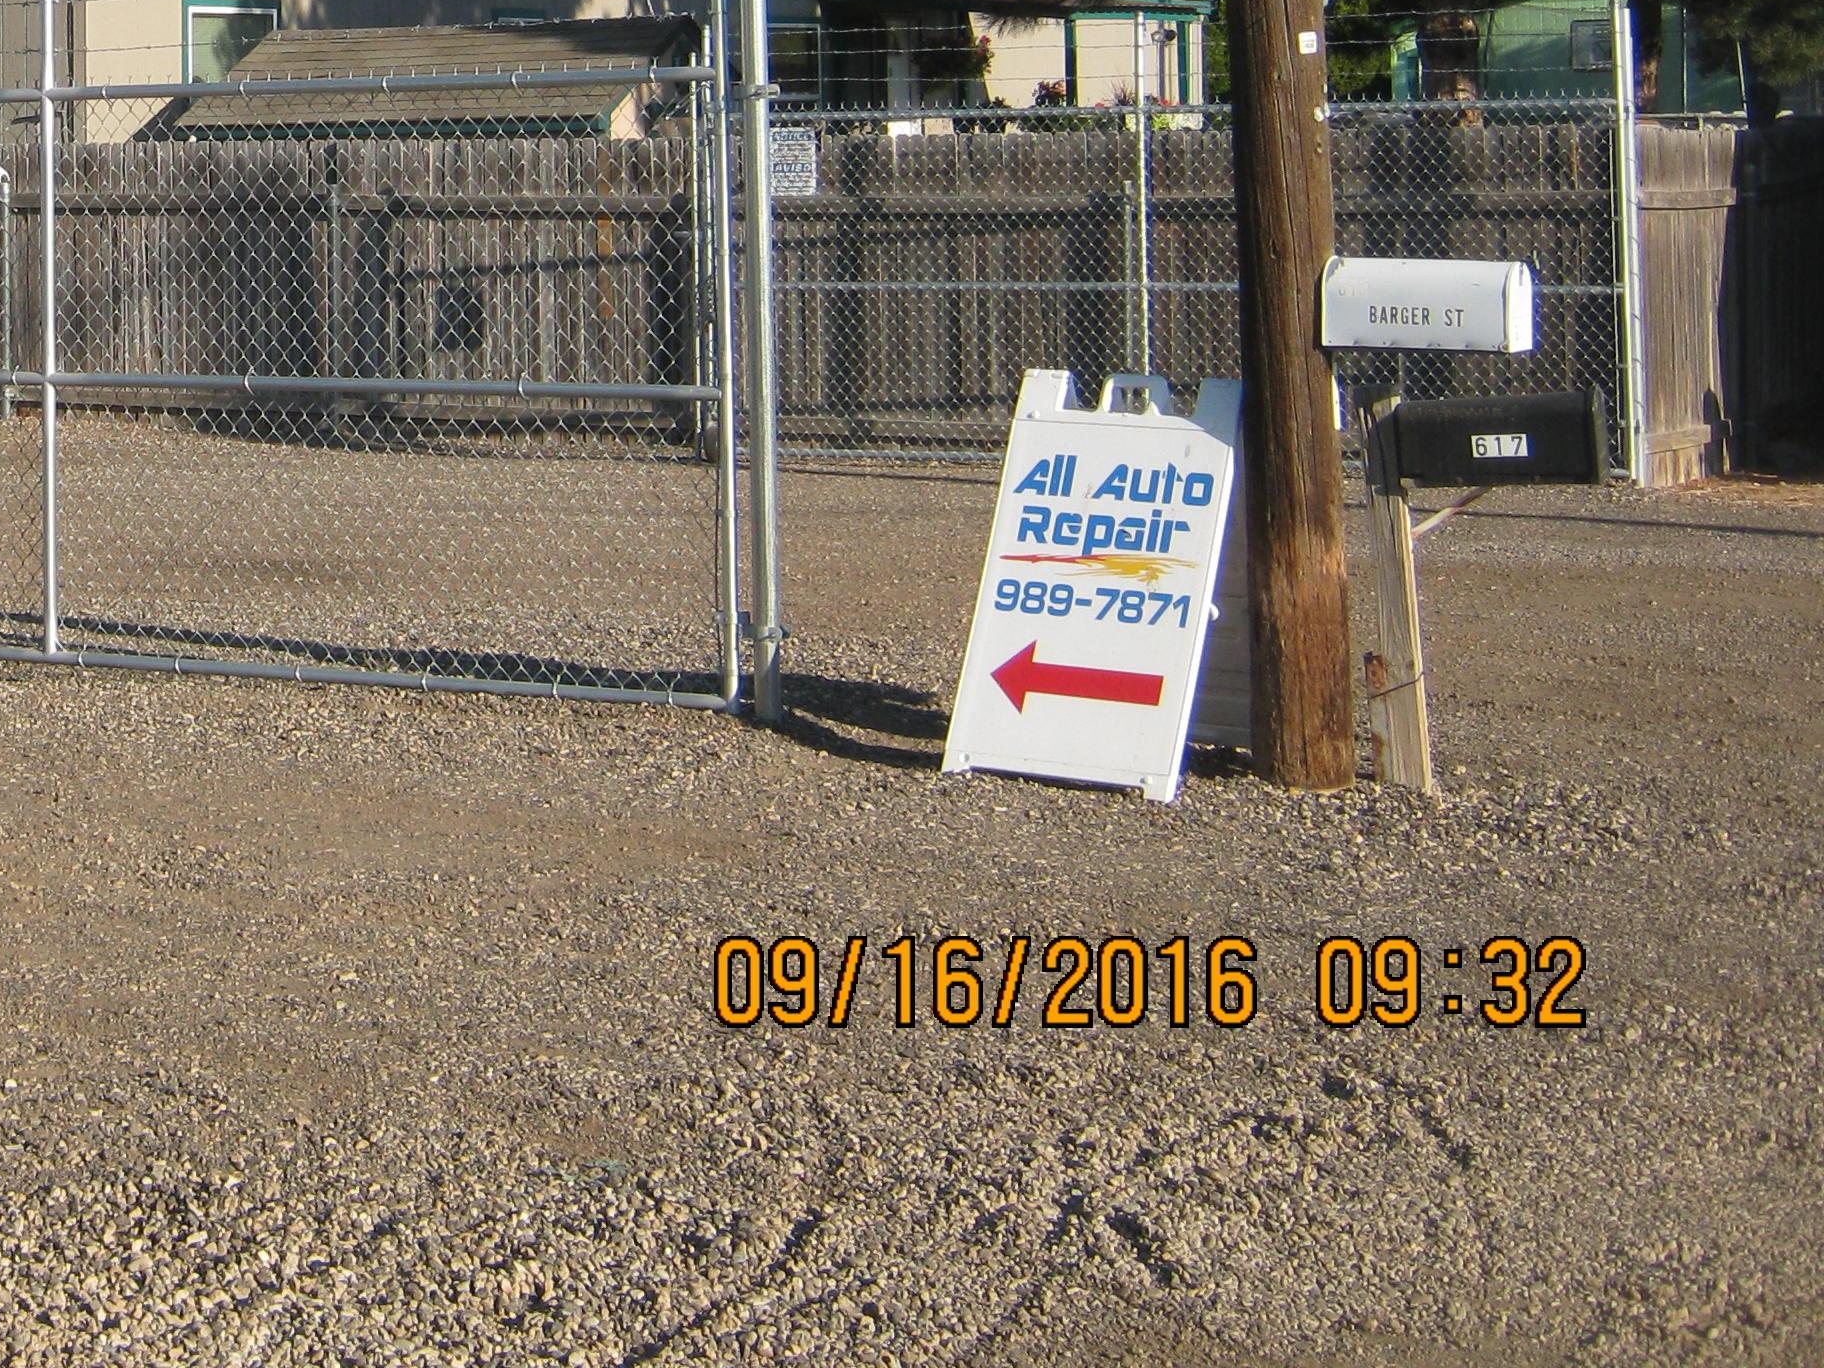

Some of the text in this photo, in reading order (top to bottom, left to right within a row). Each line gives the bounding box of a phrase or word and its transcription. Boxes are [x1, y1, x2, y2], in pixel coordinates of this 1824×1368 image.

[774, 163, 812, 172] AVISO
[1369, 305, 1465, 329] BARGER ST
[1475, 436, 1523, 456] 617
[1013, 454, 1215, 507] All Auto
[1017, 505, 1191, 556] Repair
[994, 578, 1192, 629] 989-7871
